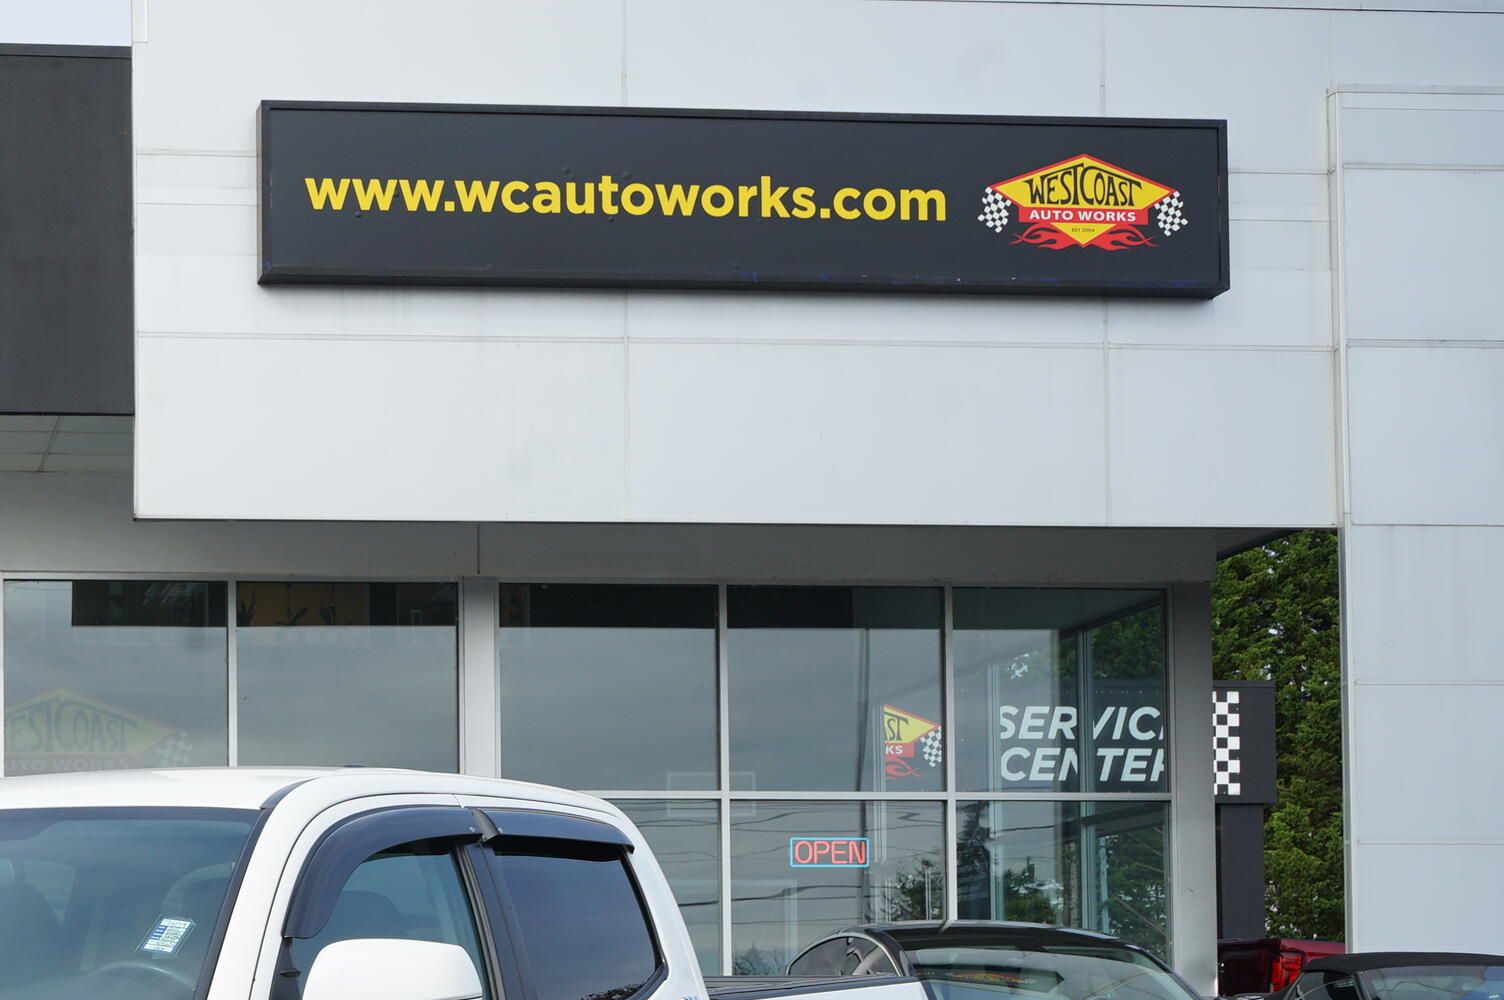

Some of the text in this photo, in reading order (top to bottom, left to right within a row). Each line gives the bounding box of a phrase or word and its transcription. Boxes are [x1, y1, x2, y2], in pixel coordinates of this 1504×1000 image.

[305, 175, 946, 221] www.wcautoworks.com
[1029, 210, 1136, 222] AUTO WORKS
[999, 705, 1164, 740] SERVIC
[794, 841, 865, 864] OPEN
